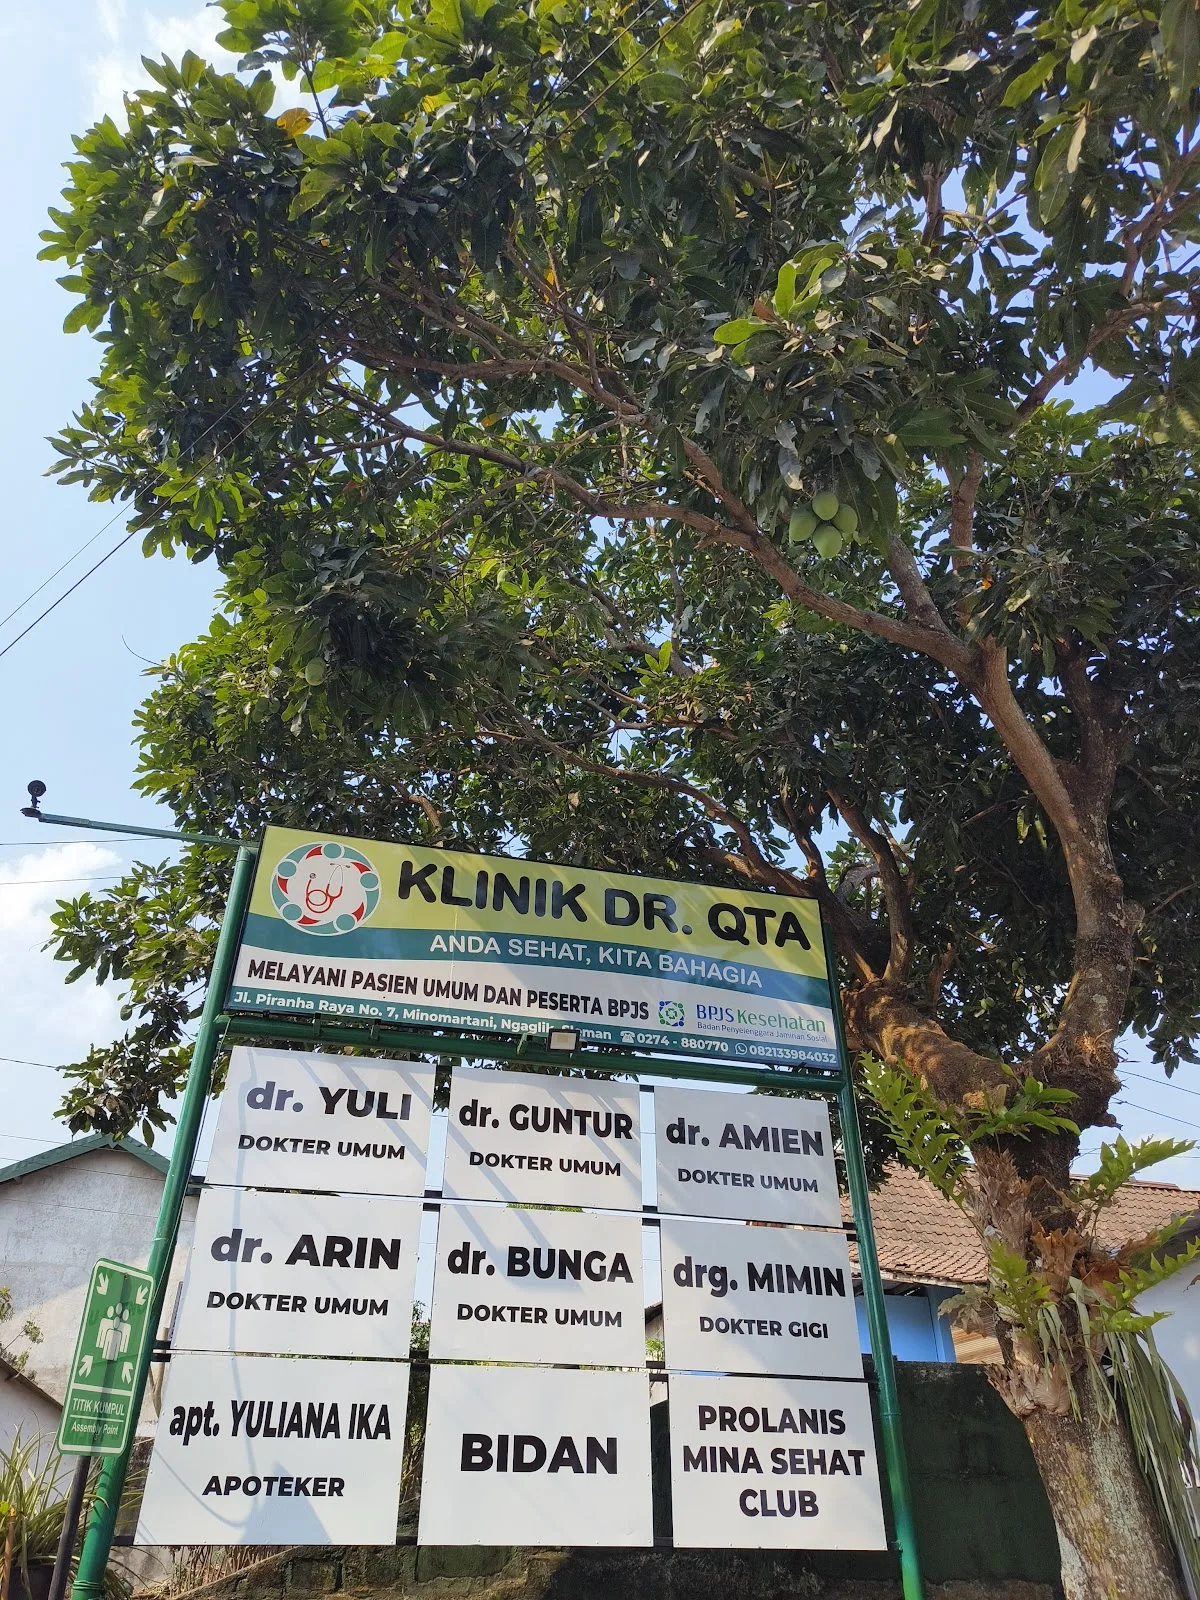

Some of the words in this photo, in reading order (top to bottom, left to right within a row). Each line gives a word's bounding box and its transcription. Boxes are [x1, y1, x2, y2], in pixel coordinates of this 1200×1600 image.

[398, 860, 587, 922] KLINIK
[604, 888, 693, 935] DR.
[708, 903, 811, 950] QTA
[430, 935, 501, 955] ANDA
[508, 938, 591, 965] SEHAT,
[599, 947, 652, 970] KITA
[659, 955, 762, 988] BAHAGIA
[248, 959, 346, 988] MELAYANI
[351, 971, 418, 995] PASIEN
[423, 978, 478, 1001] UMUM
[484, 985, 522, 1006] DAN
[527, 990, 603, 1015] PESERTA
[608, 998, 649, 1020] BPJS
[234, 992, 251, 1003] Jl.
[256, 993, 314, 1009] Piranha
[319, 1000, 354, 1015] Raya
[359, 1004, 382, 1016] No.
[386, 1007, 399, 1020] 7,
[402, 1009, 497, 1030] Minomartani,
[637, 1034, 670, 1046] 0274
[681, 1037, 729, 1052] 880770
[749, 1045, 836, 1064] 082133984032
[696, 1004, 735, 1022] BPJS
[738, 1009, 826, 1032] Kesehatan
[697, 1022, 720, 1031] Badan
[721, 1024, 774, 1037] Penyelenggara
[776, 1032, 805, 1040] Jaminan
[807, 1034, 828, 1043] Sosial
[246, 1081, 304, 1112] dr.
[319, 1086, 412, 1120] YULI
[459, 1099, 500, 1128] dr.
[509, 1104, 633, 1139] GUNTUR
[238, 1134, 331, 1155] DOKTER
[337, 1141, 405, 1159] UMUM
[666, 1117, 709, 1146] dr.
[719, 1123, 824, 1156] AMIEN
[469, 1152, 552, 1171] DOKTER
[560, 1159, 621, 1176] UMUM
[678, 1168, 754, 1188] DOKTER
[761, 1176, 818, 1193] UMUM
[211, 1228, 273, 1264] dr.
[285, 1234, 401, 1270] ARIN
[447, 1241, 495, 1276] dr.
[507, 1246, 634, 1283] BUNGA
[673, 1256, 738, 1297] drg.
[747, 1262, 846, 1297] MIMIN
[206, 1291, 307, 1312] DOKTER
[314, 1297, 389, 1316] UMUM
[457, 1304, 547, 1324] DOKTER
[555, 1308, 622, 1327] UMUM
[700, 1316, 782, 1336] DOKTER
[788, 1322, 828, 1339] GIGI
[73, 1398, 92, 1412] TITIK
[93, 1401, 125, 1416] KUMPUL
[699, 1405, 846, 1435] PROLANIS
[71, 1421, 102, 1435] Assembly
[103, 1424, 118, 1435] Point
[169, 1401, 220, 1446] apt.
[231, 1400, 340, 1438] YULIANA
[348, 1404, 391, 1440] IKA
[460, 1433, 617, 1474] BIDAN
[683, 1445, 762, 1473] MINA
[771, 1448, 865, 1476] SEHAT
[202, 1476, 345, 1497] APOTEKER
[739, 1489, 819, 1518] CLUB
